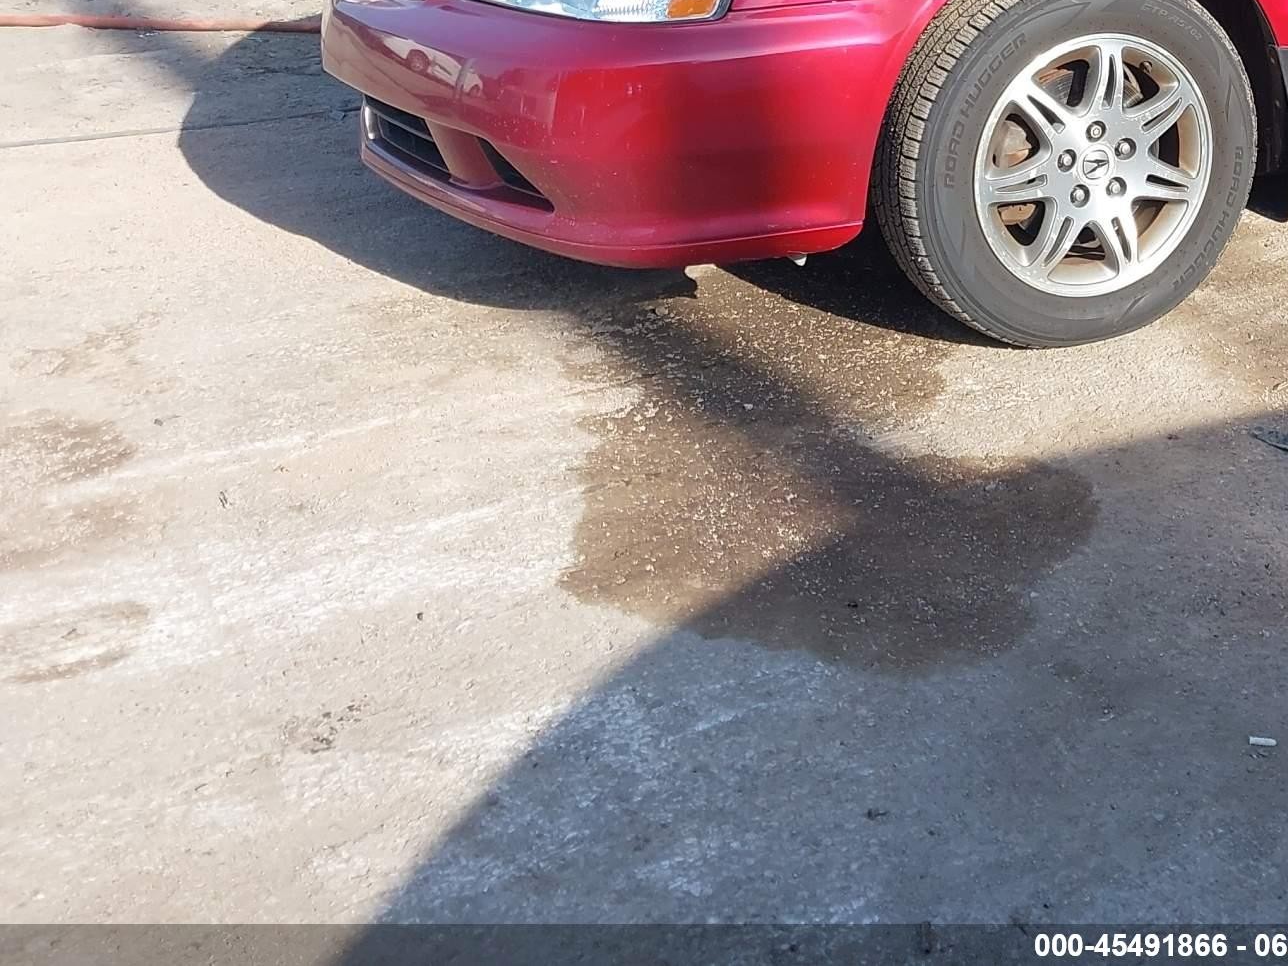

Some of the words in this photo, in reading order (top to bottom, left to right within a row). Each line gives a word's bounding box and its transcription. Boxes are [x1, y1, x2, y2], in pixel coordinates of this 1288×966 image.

[944, 119, 964, 188] ROAD
[960, 32, 1027, 118] HUGGER
[1226, 146, 1243, 207] ROAD
[1173, 210, 1230, 291] HUGGER
